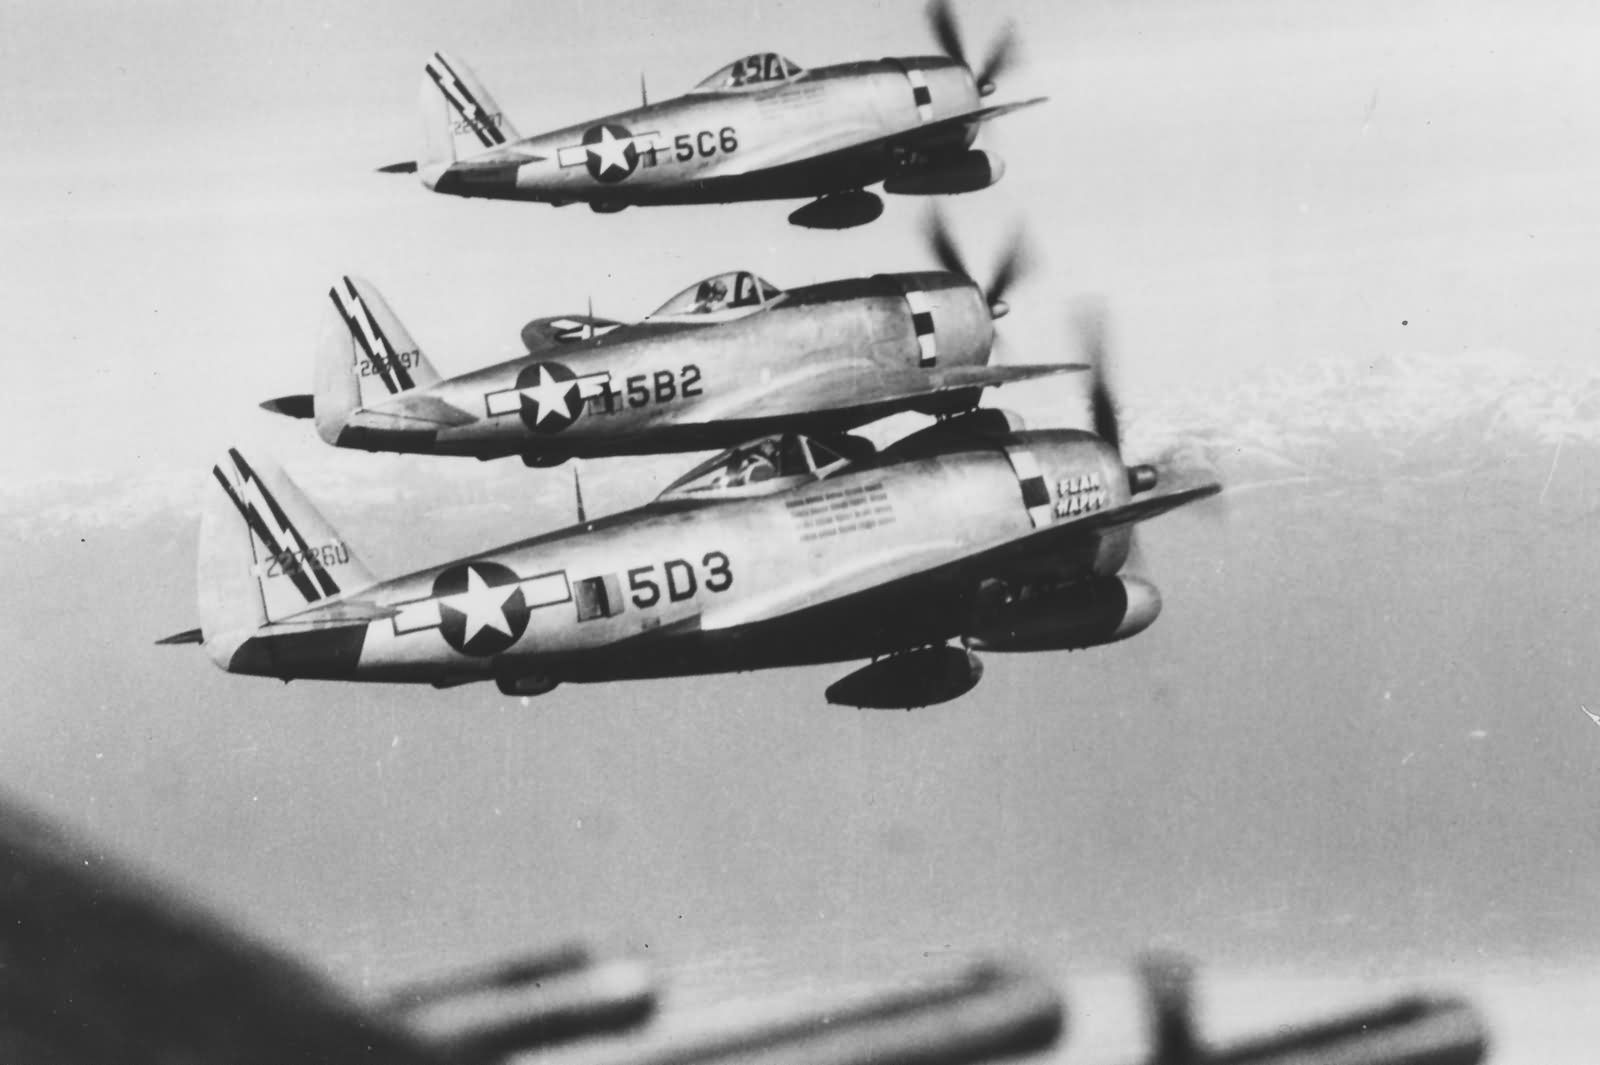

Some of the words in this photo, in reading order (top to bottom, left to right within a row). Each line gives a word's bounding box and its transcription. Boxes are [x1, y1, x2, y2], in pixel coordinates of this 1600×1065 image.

[674, 126, 738, 163] 5C6
[626, 364, 703, 409] 5B2
[627, 551, 734, 610] 5D3
